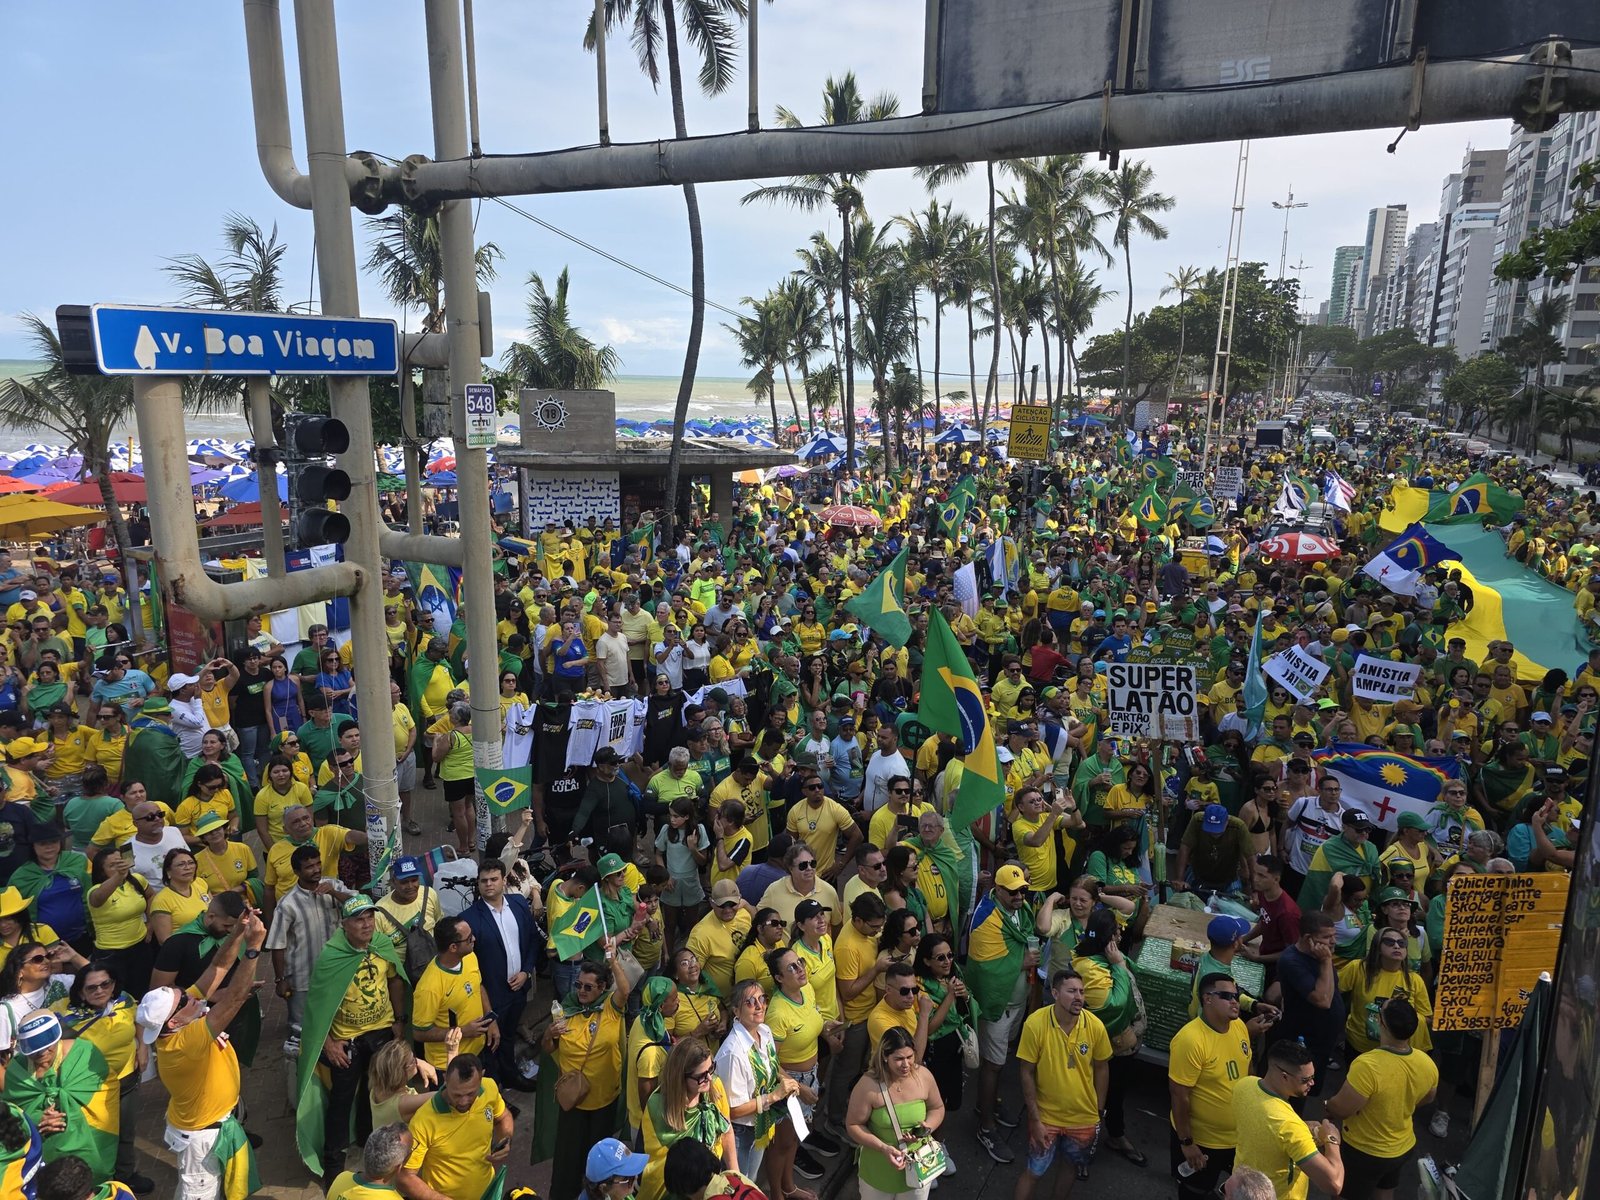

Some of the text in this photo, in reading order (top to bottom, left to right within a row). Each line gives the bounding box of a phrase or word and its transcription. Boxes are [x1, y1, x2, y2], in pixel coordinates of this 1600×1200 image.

[204, 328, 263, 356] Boa
[468, 395, 492, 412] 548
[545, 408, 557, 419] 18
[1176, 472, 1204, 481] SUPER
[1282, 648, 1320, 681] ANISTIA
[1110, 665, 1192, 691] SUPER
[1358, 663, 1411, 682] ANISTIA
[1356, 677, 1395, 694] AMPLA
[1110, 689, 1193, 715] LATÃO
[610, 713, 627, 728] FORA
[1112, 723, 1118, 732] E
[609, 726, 625, 743] LULA
[552, 780, 579, 793] LULA!
[554, 778, 576, 787] FORA
[934, 884, 945, 898] 10
[1445, 949, 1503, 963] Red BULL
[1442, 962, 1492, 973] Brahma
[1440, 974, 1494, 985] Devassa
[1226, 1060, 1239, 1081] 10
